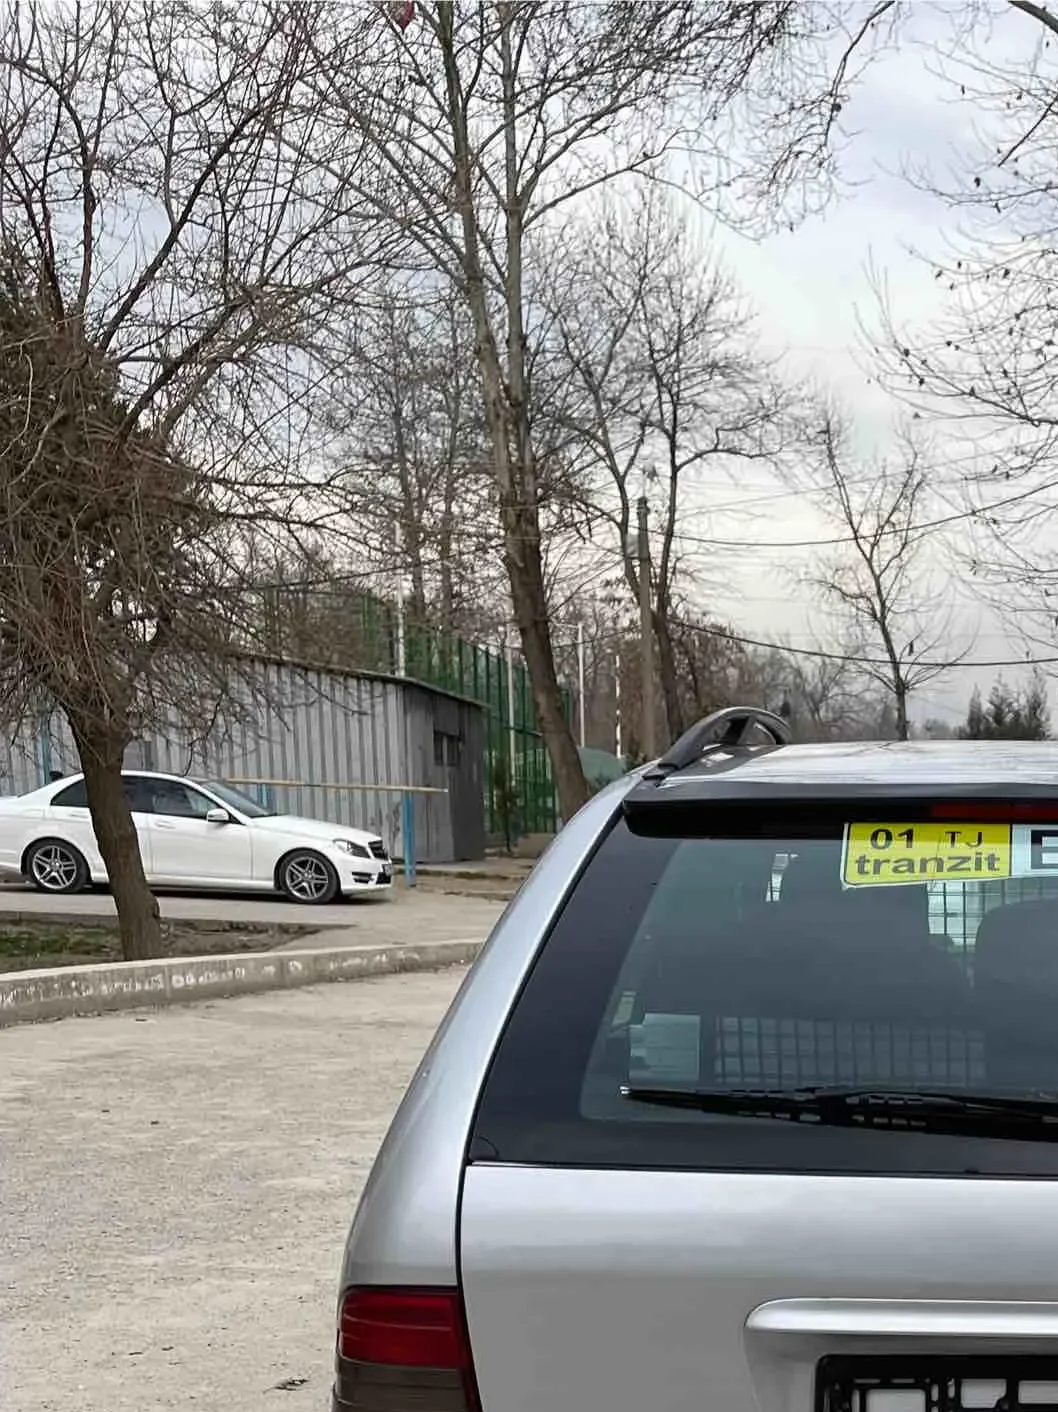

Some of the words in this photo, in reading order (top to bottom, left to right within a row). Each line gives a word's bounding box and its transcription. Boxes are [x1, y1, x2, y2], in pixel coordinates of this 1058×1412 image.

[870, 828, 914, 850] 01
[944, 831, 983, 848] TJ
[854, 852, 1001, 876] tranzit
